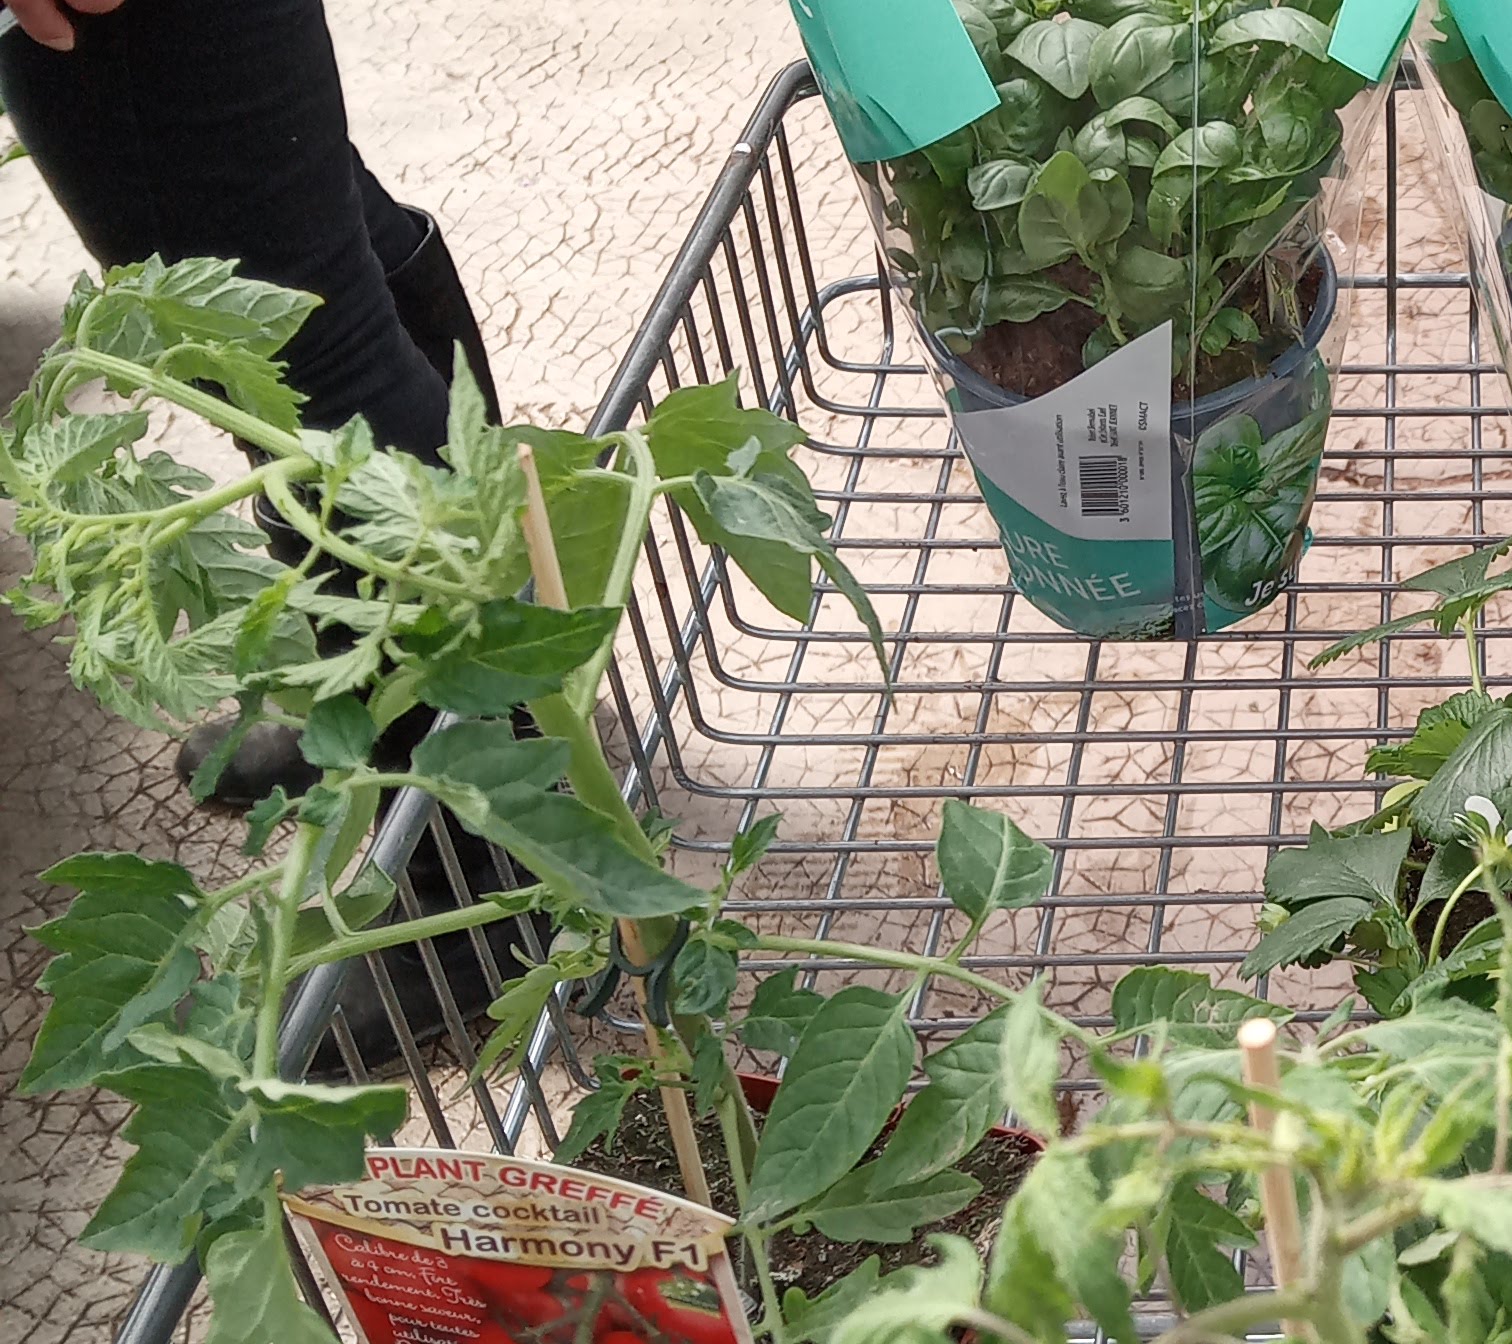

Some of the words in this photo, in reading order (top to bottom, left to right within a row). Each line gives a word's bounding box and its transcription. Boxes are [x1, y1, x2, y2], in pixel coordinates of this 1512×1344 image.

[1244, 580, 1275, 607] Je
[367, 1156, 486, 1182] PLANT
[499, 1166, 664, 1220] GREFFÉ
[342, 1194, 461, 1218] Tomate
[472, 1201, 600, 1224] cocktail
[335, 1233, 410, 1261] Calibre
[411, 1250, 434, 1266] de
[440, 1227, 635, 1266] Harmony
[652, 1240, 701, 1266] F1
[364, 1288, 418, 1311] bonne
[389, 1313, 428, 1326] pour
[430, 1321, 480, 1338] toutes
